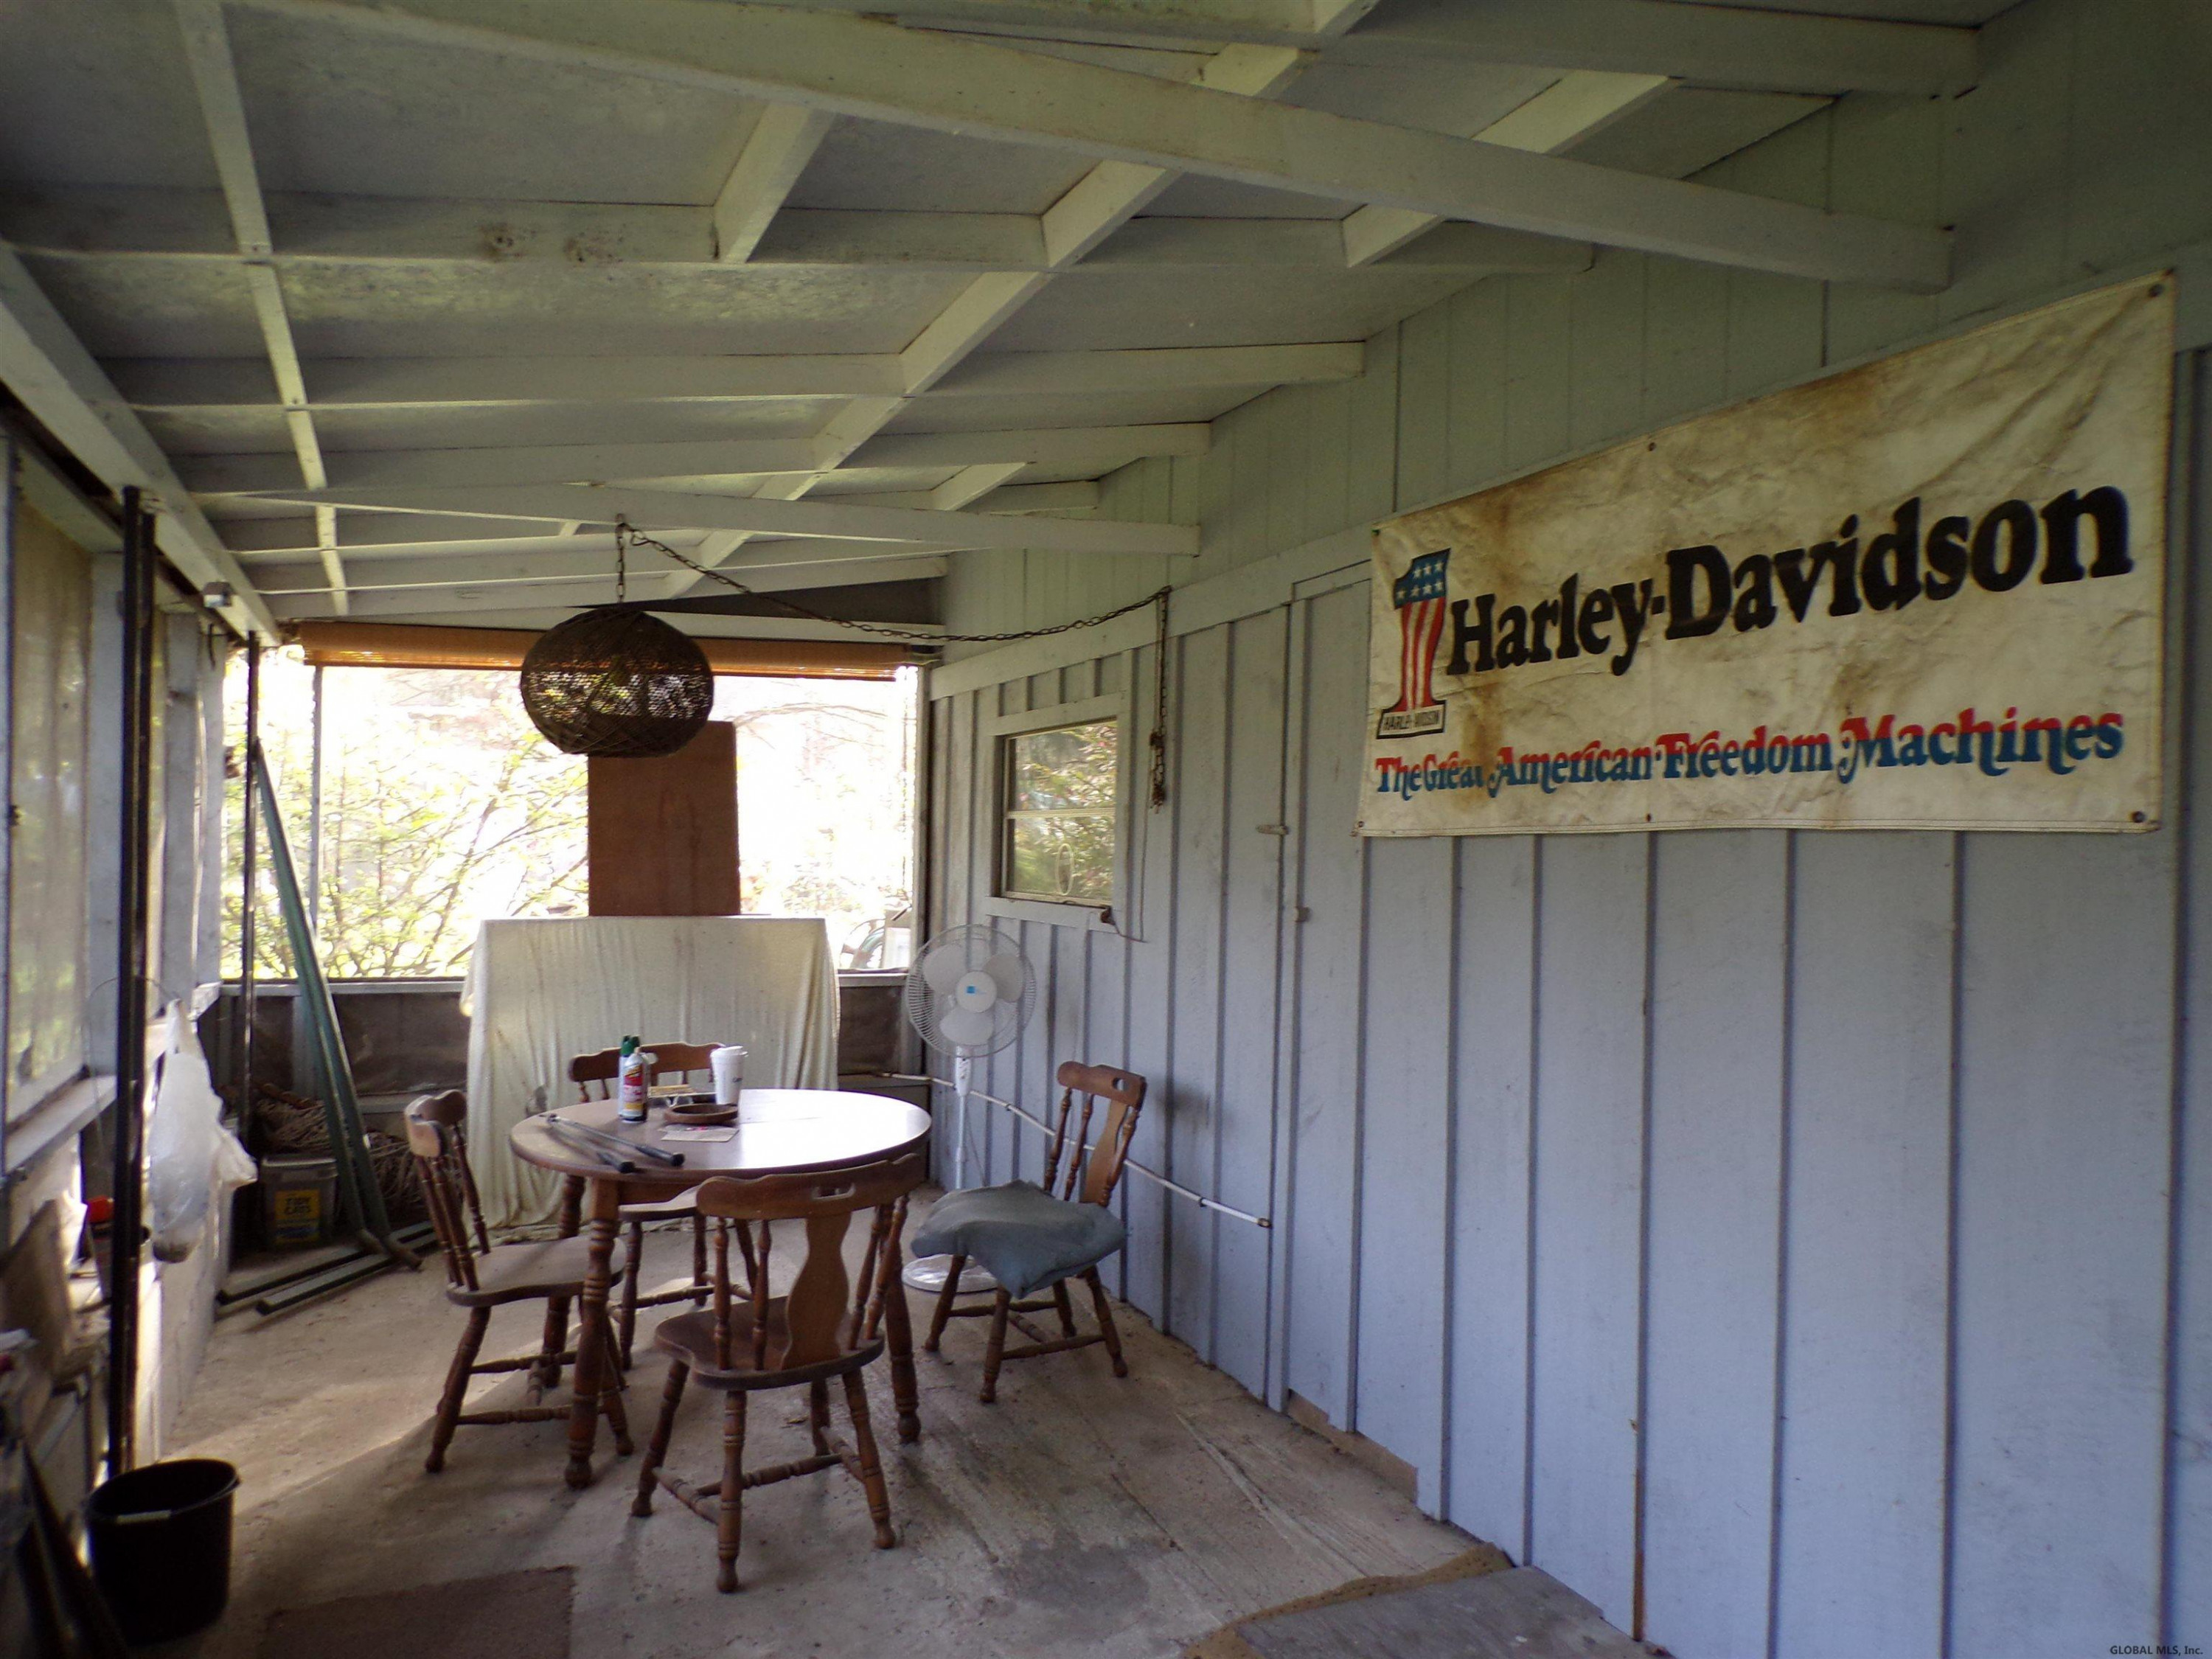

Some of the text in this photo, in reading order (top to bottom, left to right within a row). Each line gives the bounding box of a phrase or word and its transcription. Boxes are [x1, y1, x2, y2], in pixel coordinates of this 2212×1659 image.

[1447, 485, 2135, 676] Harley-Davidson
[1487, 740, 1652, 798] American
[1838, 706, 2124, 784] Machines
